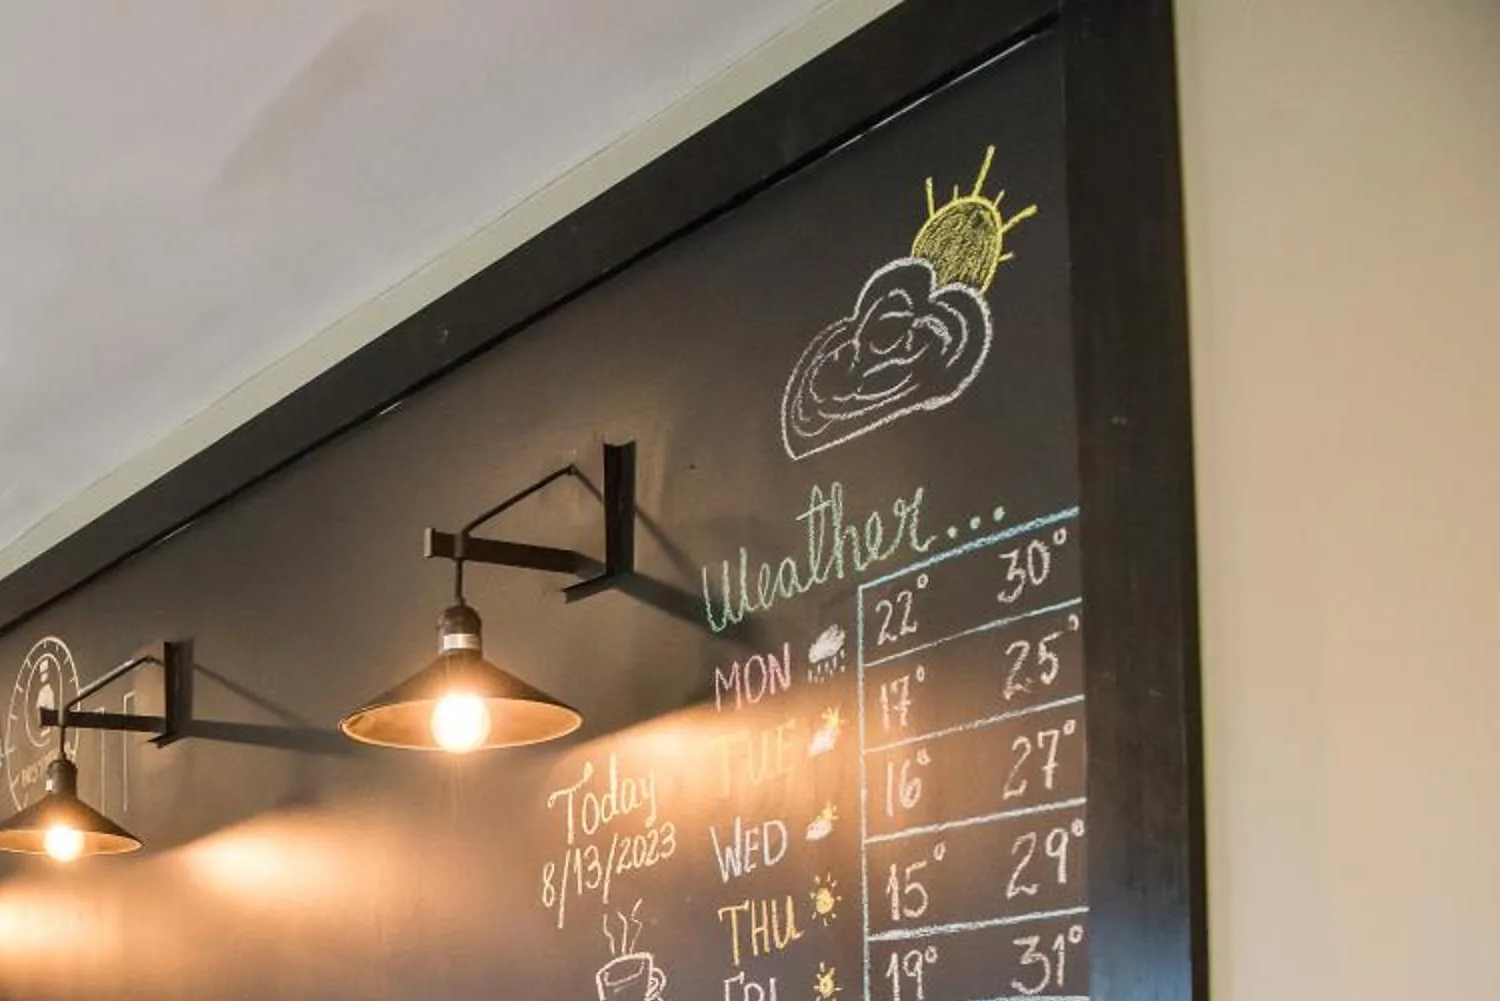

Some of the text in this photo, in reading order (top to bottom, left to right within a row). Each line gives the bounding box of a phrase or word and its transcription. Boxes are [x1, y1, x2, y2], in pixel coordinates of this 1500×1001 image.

[712, 642, 791, 713] MON
[710, 717, 797, 796] TUE
[548, 753, 657, 845] Today
[542, 821, 677, 928] 8/13/2023
[710, 819, 788, 882] WED
[718, 895, 804, 966] THU
